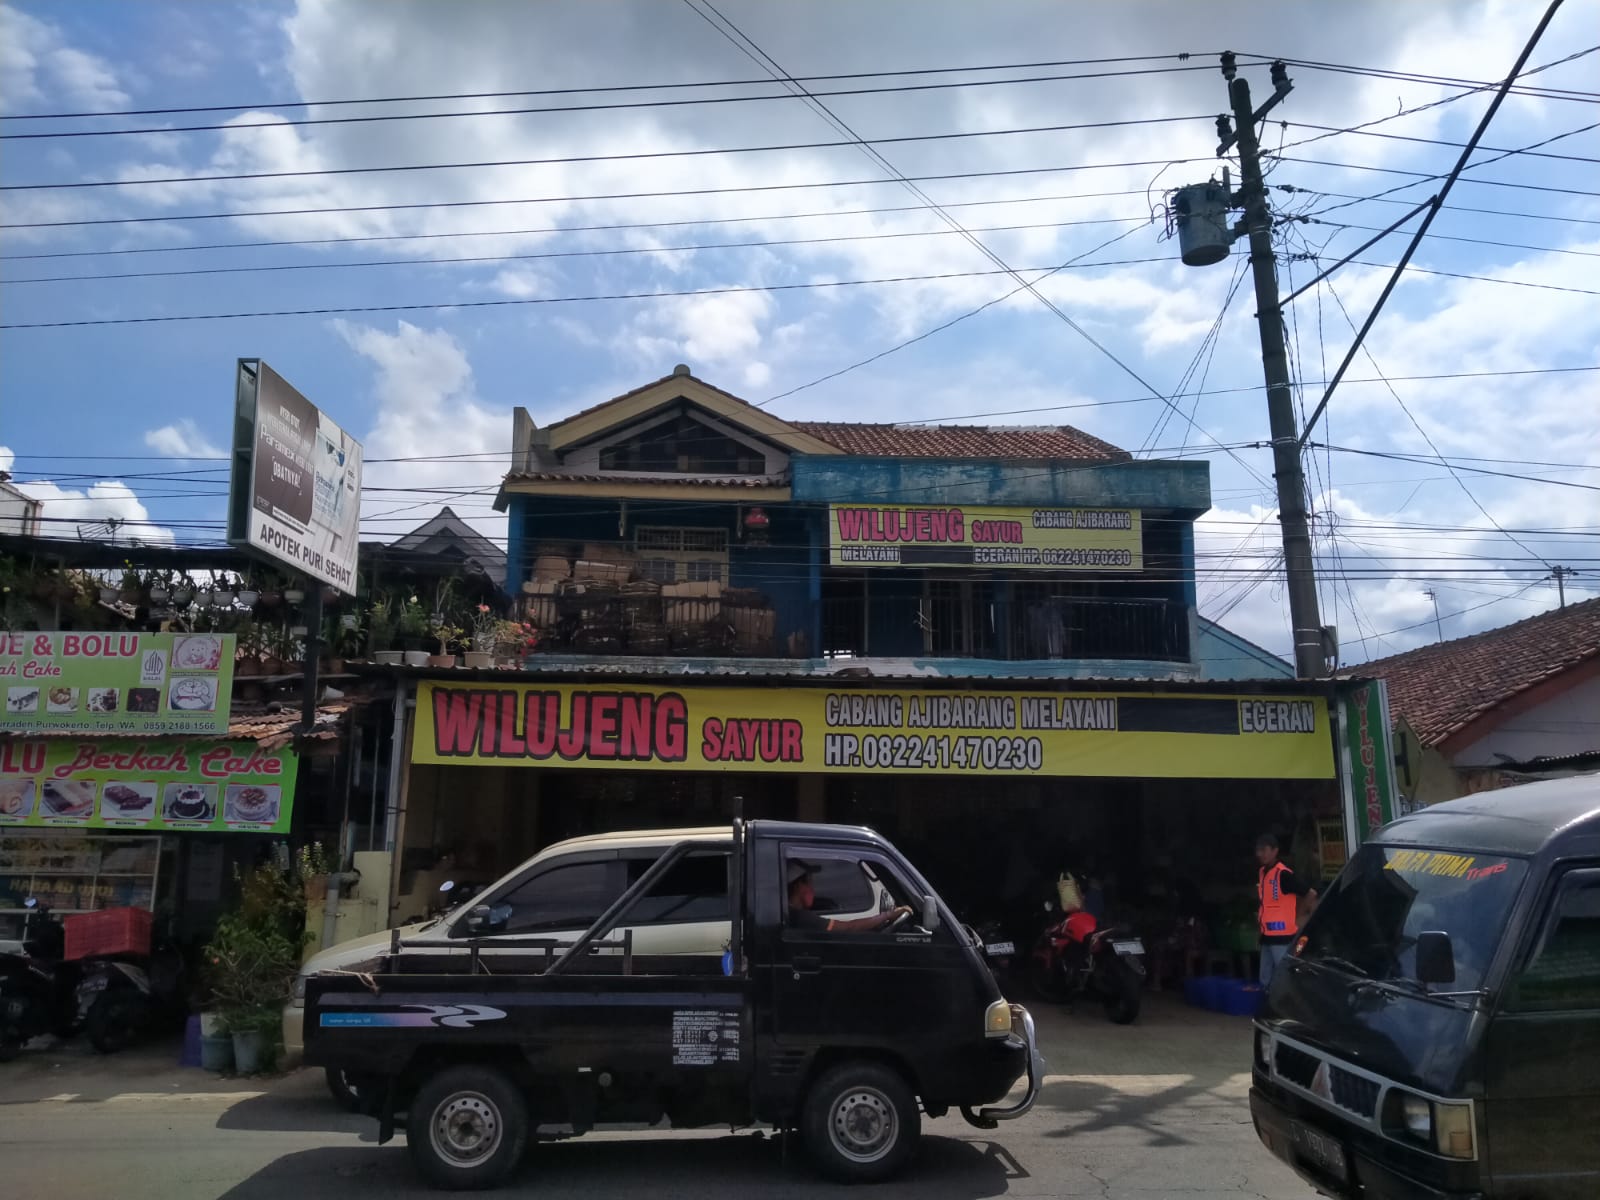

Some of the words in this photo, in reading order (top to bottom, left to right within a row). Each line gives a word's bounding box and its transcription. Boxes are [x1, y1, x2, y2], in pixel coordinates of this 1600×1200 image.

[837, 507, 965, 542] WILUJENG
[971, 520, 1024, 544] SAYUR
[1033, 510, 1074, 529] CABANG
[1075, 510, 1132, 530] AJIBARANG
[260, 523, 301, 560] APOTEK
[302, 543, 323, 572] PURI
[325, 558, 352, 588] SEHAT
[840, 546, 900, 564] MELAYANI
[974, 548, 1022, 564] ECERAN
[1043, 549, 1132, 566] 082241470230
[33, 634, 54, 656] &
[63, 635, 139, 657] BOLU
[23, 660, 61, 679] Cake
[432, 688, 689, 762] WILUJENG
[702, 717, 804, 762] SAYUR
[825, 694, 904, 728] CABANG
[908, 696, 1016, 729] AJIBARANG
[1021, 696, 1117, 730] MELAYANI
[1240, 700, 1316, 733] ECERAN
[55, 744, 189, 778] Berkah
[200, 746, 282, 777] Cake
[1352, 686, 1383, 837] WILUJEN
[1430, 853, 1477, 879] PRIMA
